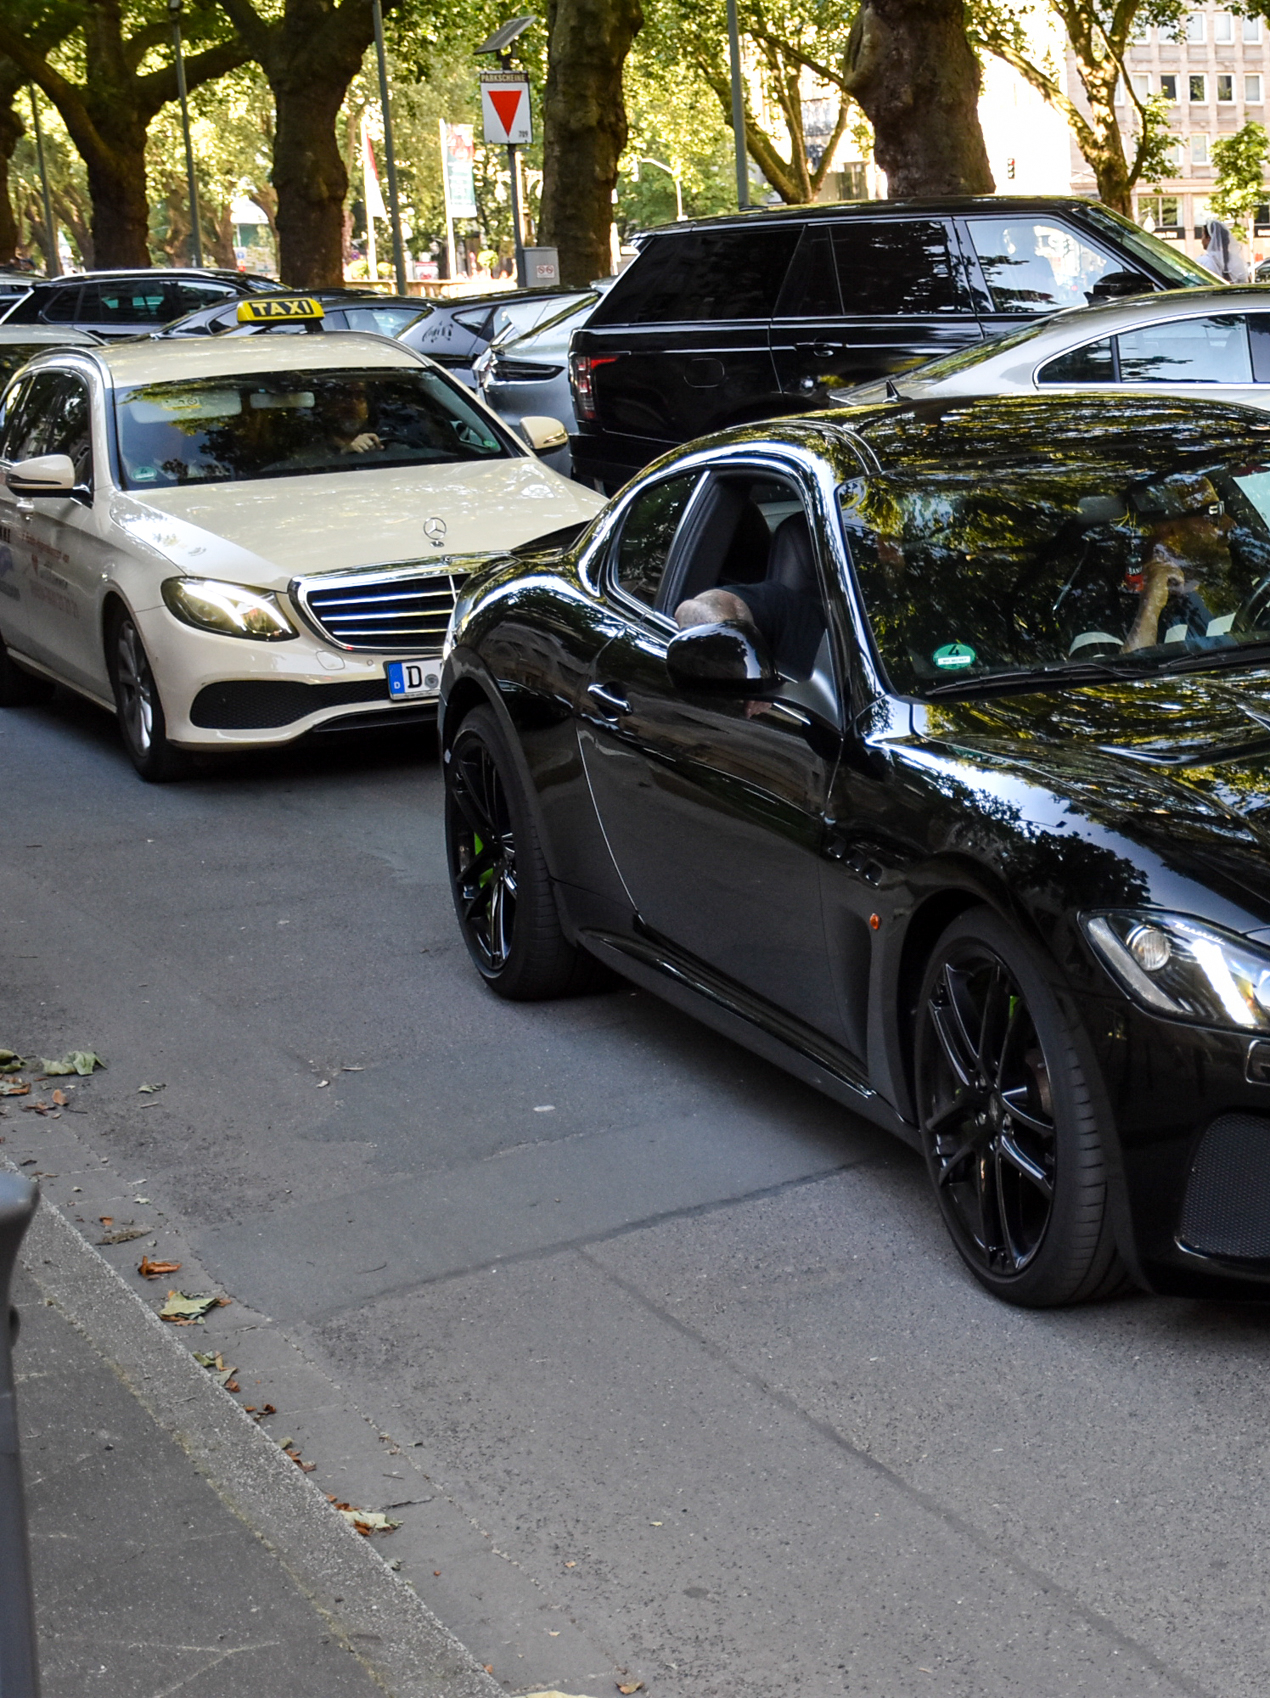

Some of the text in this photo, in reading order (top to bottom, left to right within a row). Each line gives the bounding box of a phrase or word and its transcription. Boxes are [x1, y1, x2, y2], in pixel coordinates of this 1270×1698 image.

[481, 74, 526, 83] PARKSCHEINE
[251, 299, 312, 316] TAXI
[948, 644, 960, 656] 4
[394, 665, 423, 689] D D
